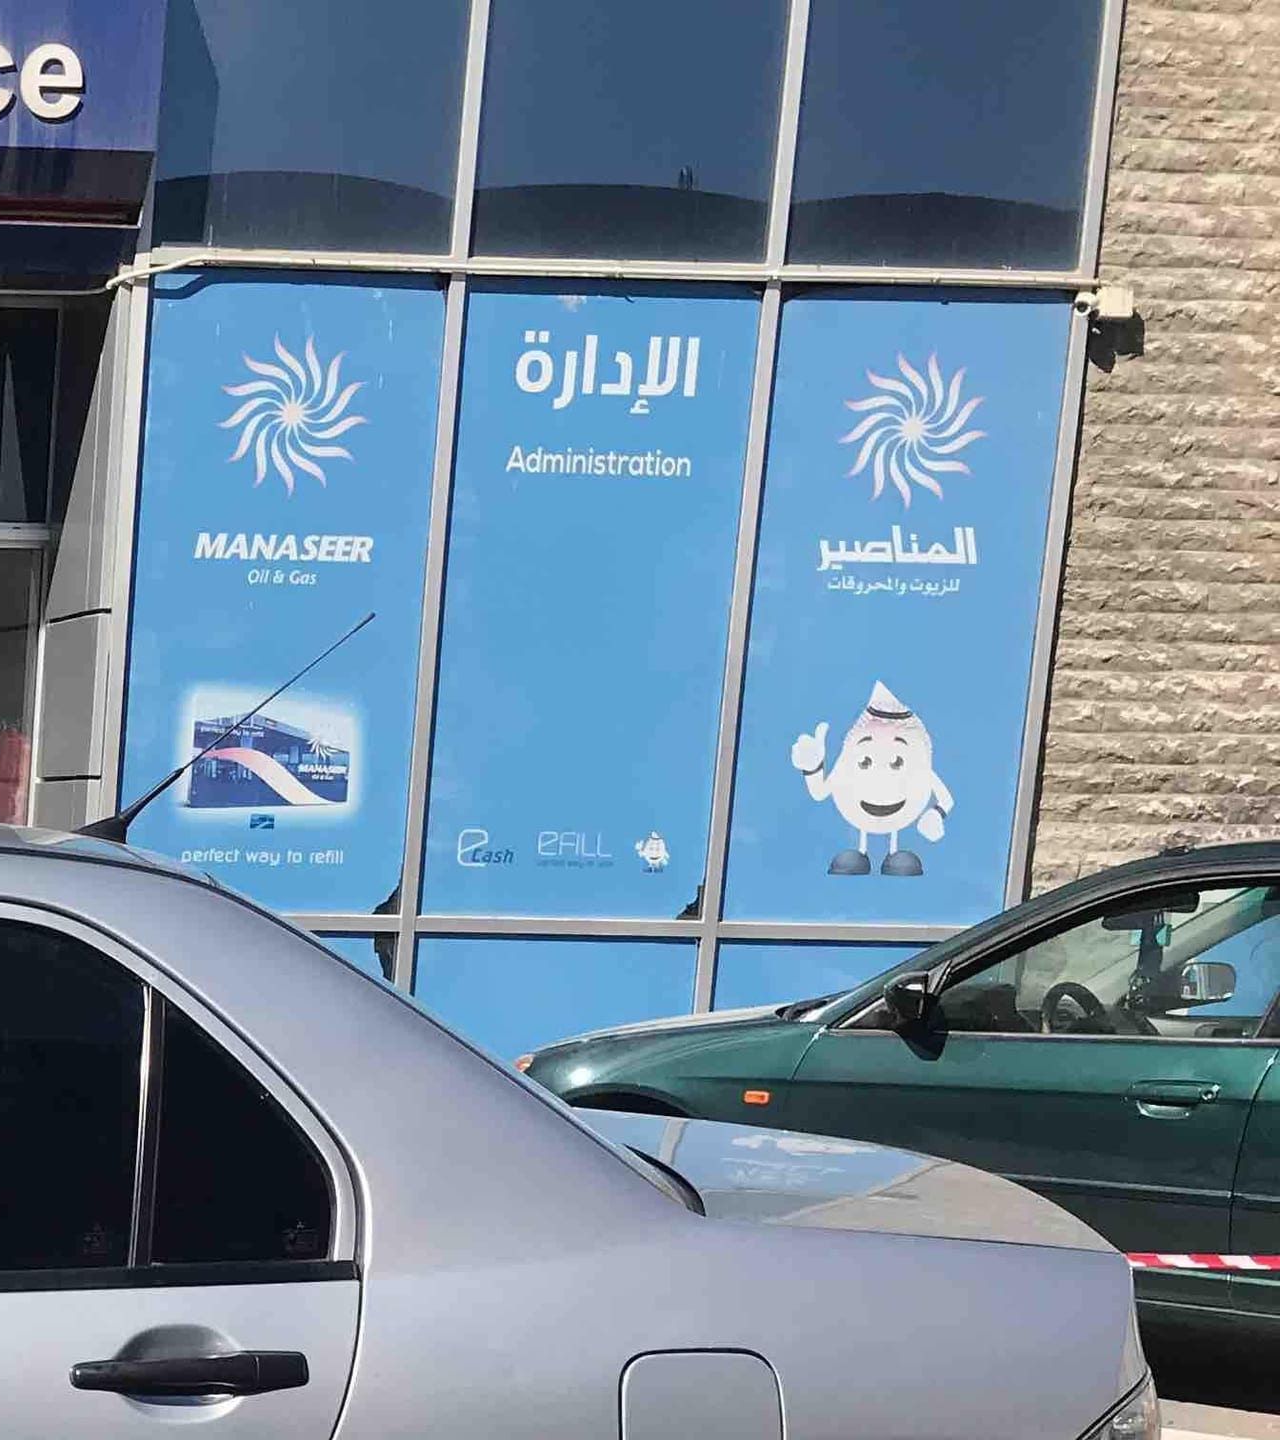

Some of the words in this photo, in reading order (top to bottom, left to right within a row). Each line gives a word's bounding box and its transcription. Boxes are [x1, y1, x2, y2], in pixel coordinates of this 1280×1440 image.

[515, 330, 700, 414] الإدارة
[505, 446, 691, 477] Administration
[194, 532, 374, 563] MANASEER
[816, 525, 978, 571] المناصير
[247, 569, 269, 585] Oil
[273, 570, 285, 585] &
[290, 570, 318, 585] Gas
[181, 848, 240, 863] perfect
[246, 851, 281, 866] way
[287, 849, 302, 863] to
[309, 850, 344, 864] refill
